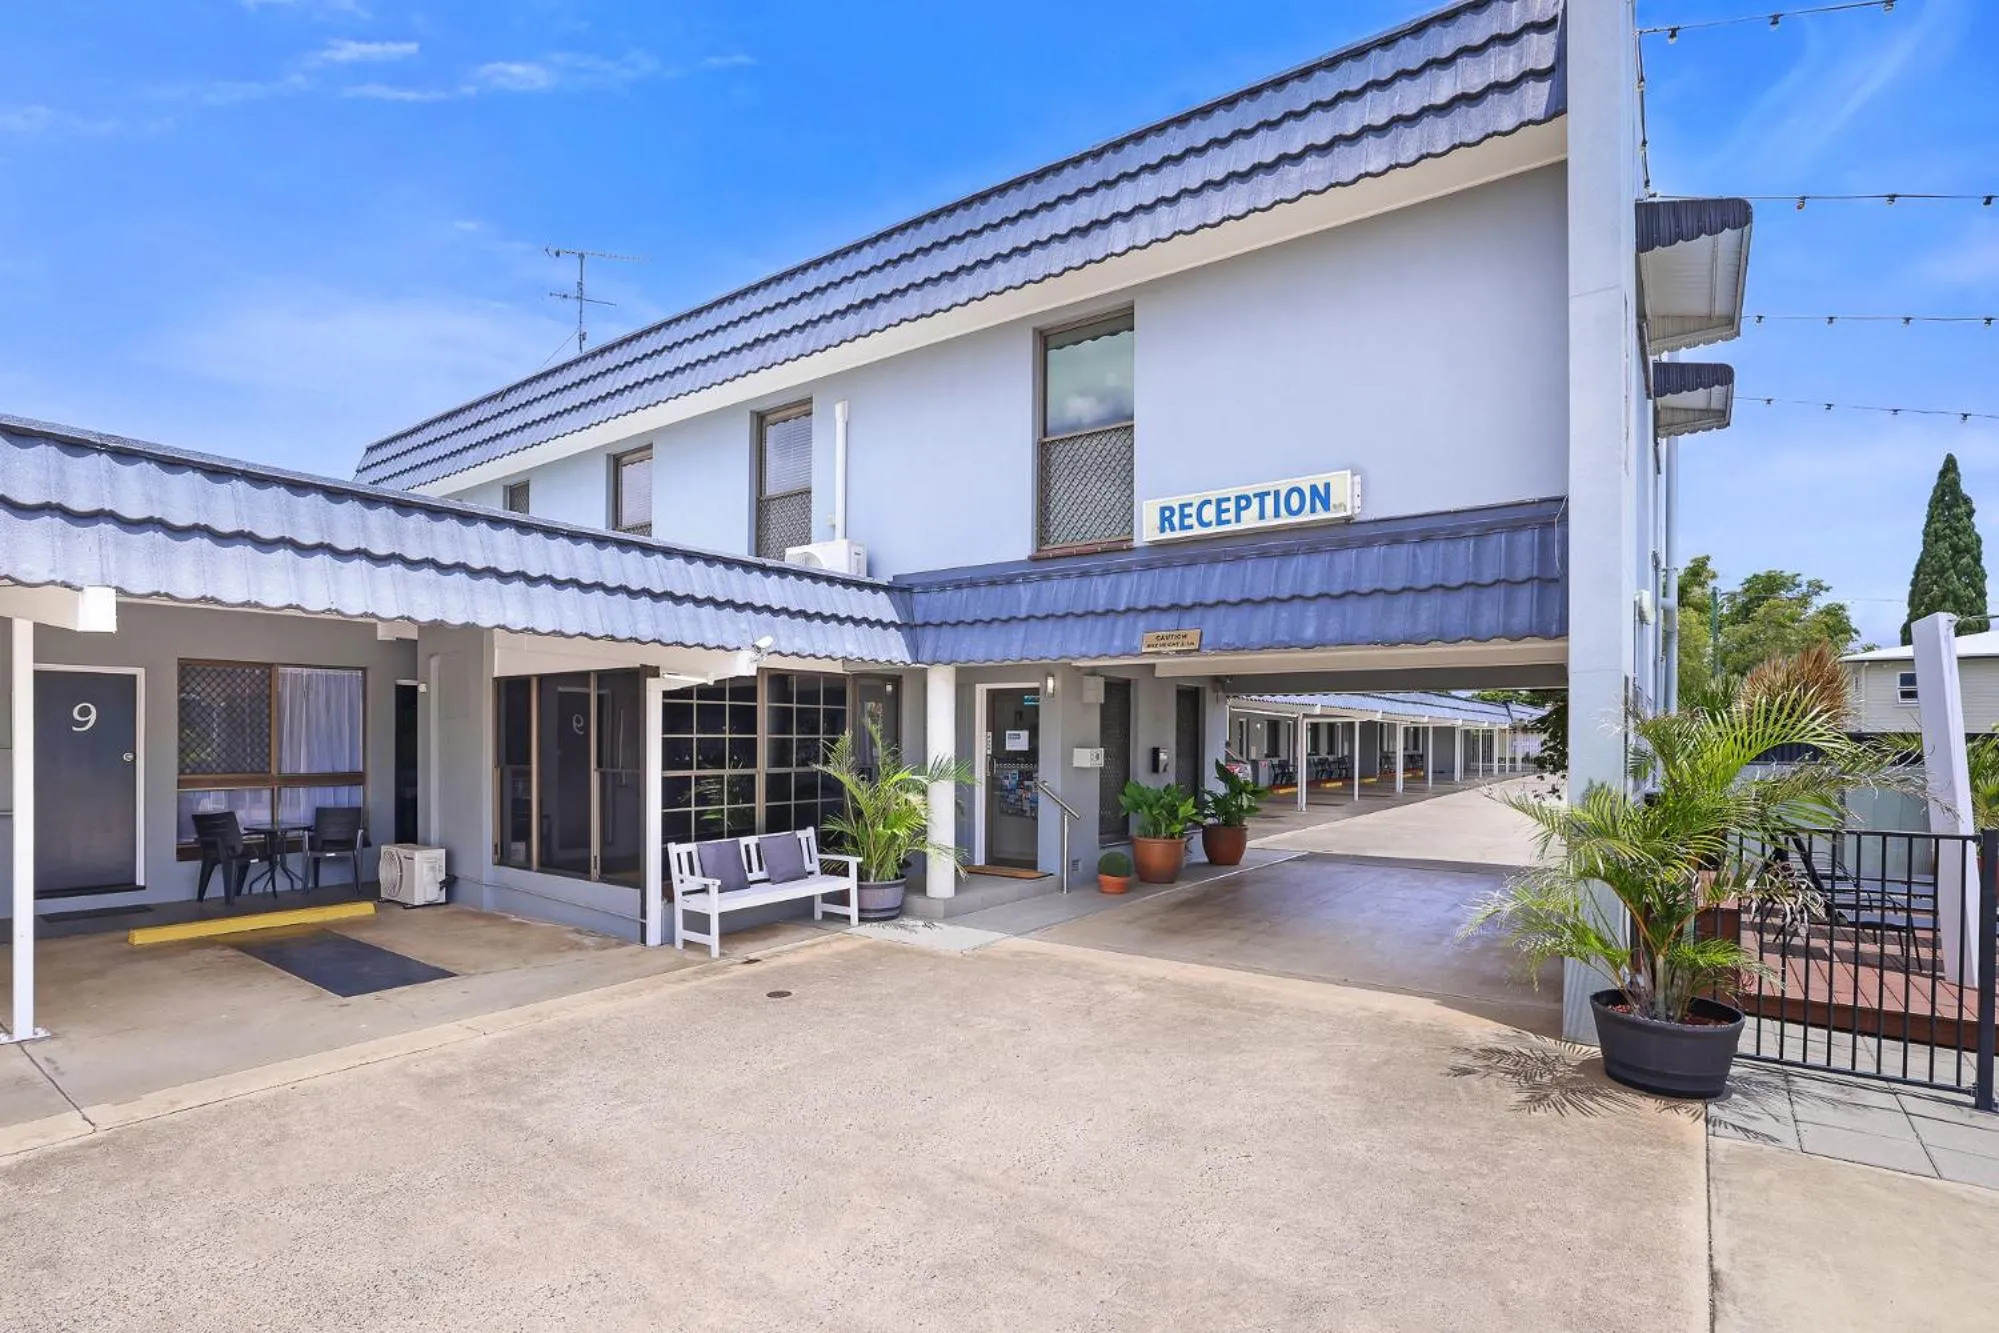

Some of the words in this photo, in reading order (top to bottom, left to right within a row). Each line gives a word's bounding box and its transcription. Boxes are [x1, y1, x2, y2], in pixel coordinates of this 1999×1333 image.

[1159, 482, 1331, 534] RECEPTION
[1155, 633, 1187, 641] CAUTION
[72, 702, 97, 732] 9
